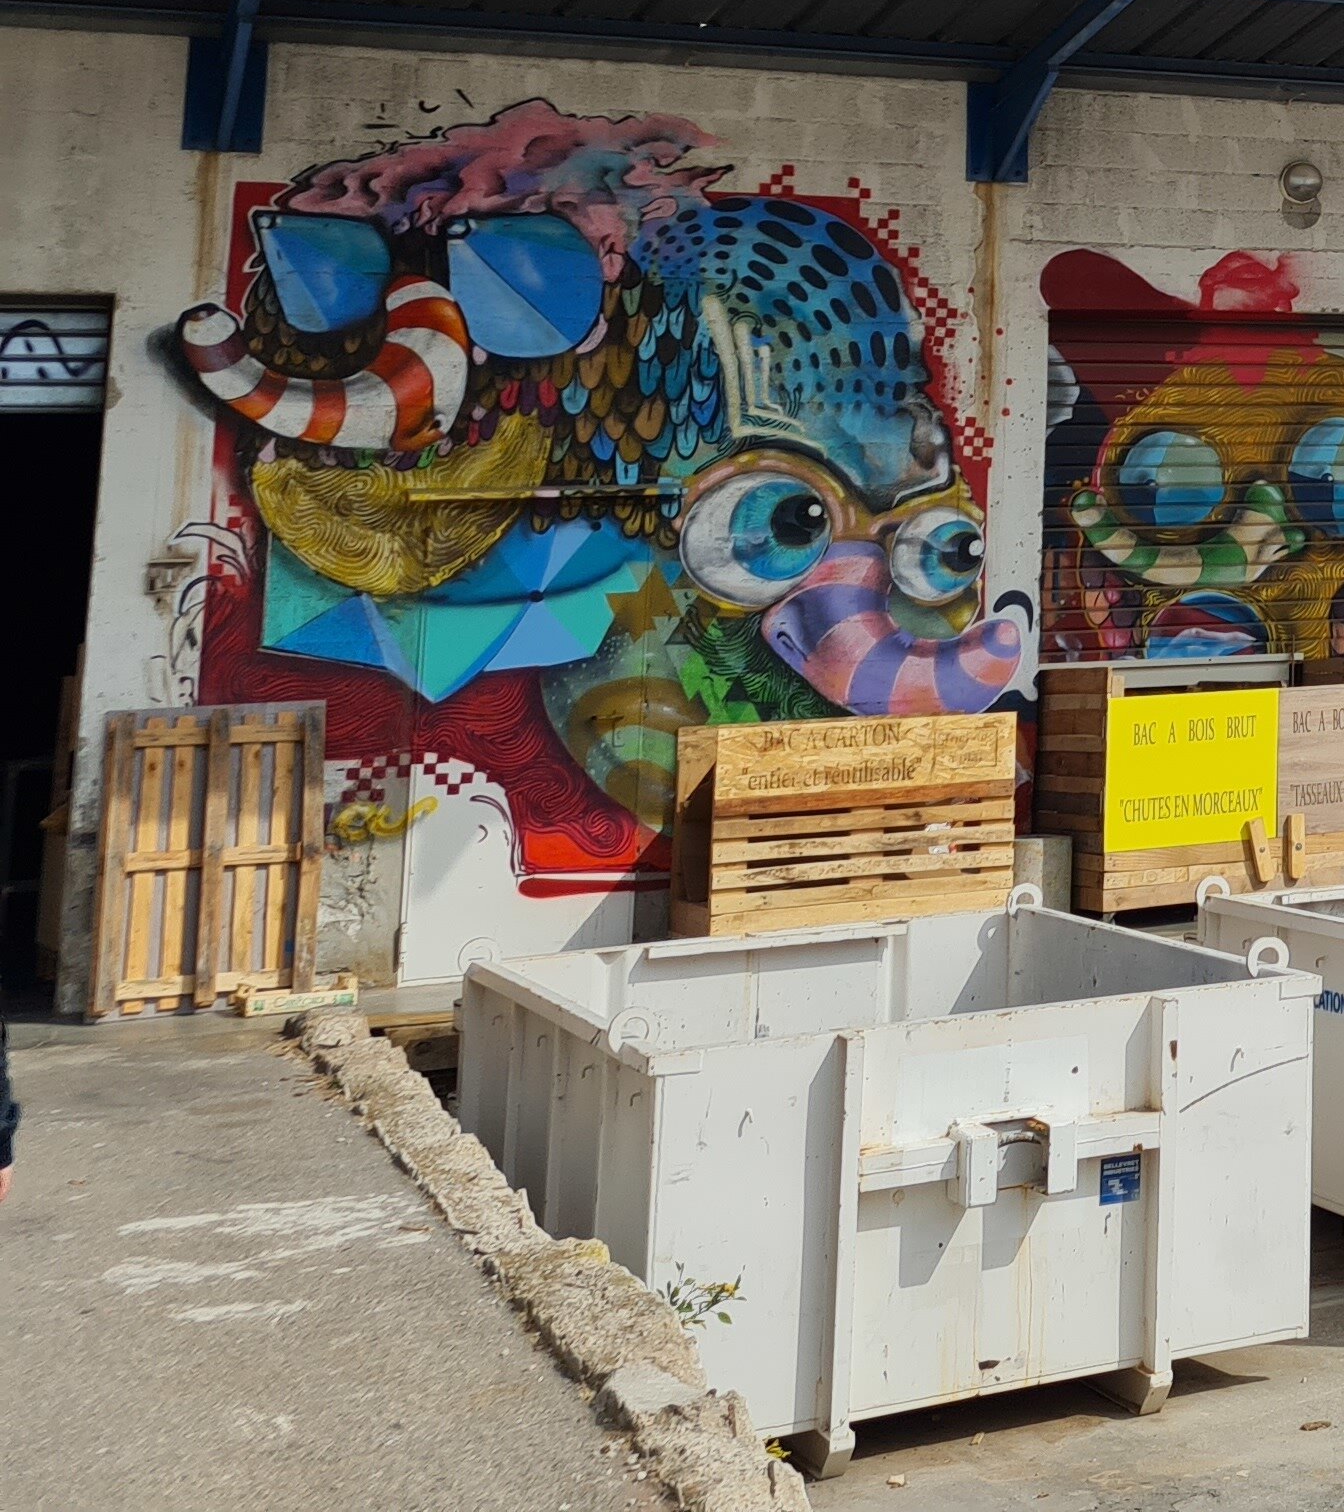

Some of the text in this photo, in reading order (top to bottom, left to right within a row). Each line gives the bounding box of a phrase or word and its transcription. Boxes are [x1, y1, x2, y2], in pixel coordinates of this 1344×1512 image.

[1133, 715, 1256, 745] BAC A BOIS BRUT
[1293, 711, 1311, 733] BAC
[1318, 710, 1325, 731] A
[763, 729, 800, 752] BAC
[823, 722, 901, 749] CARTON
[803, 768, 820, 787] et
[1174, 794, 1190, 818] EN
